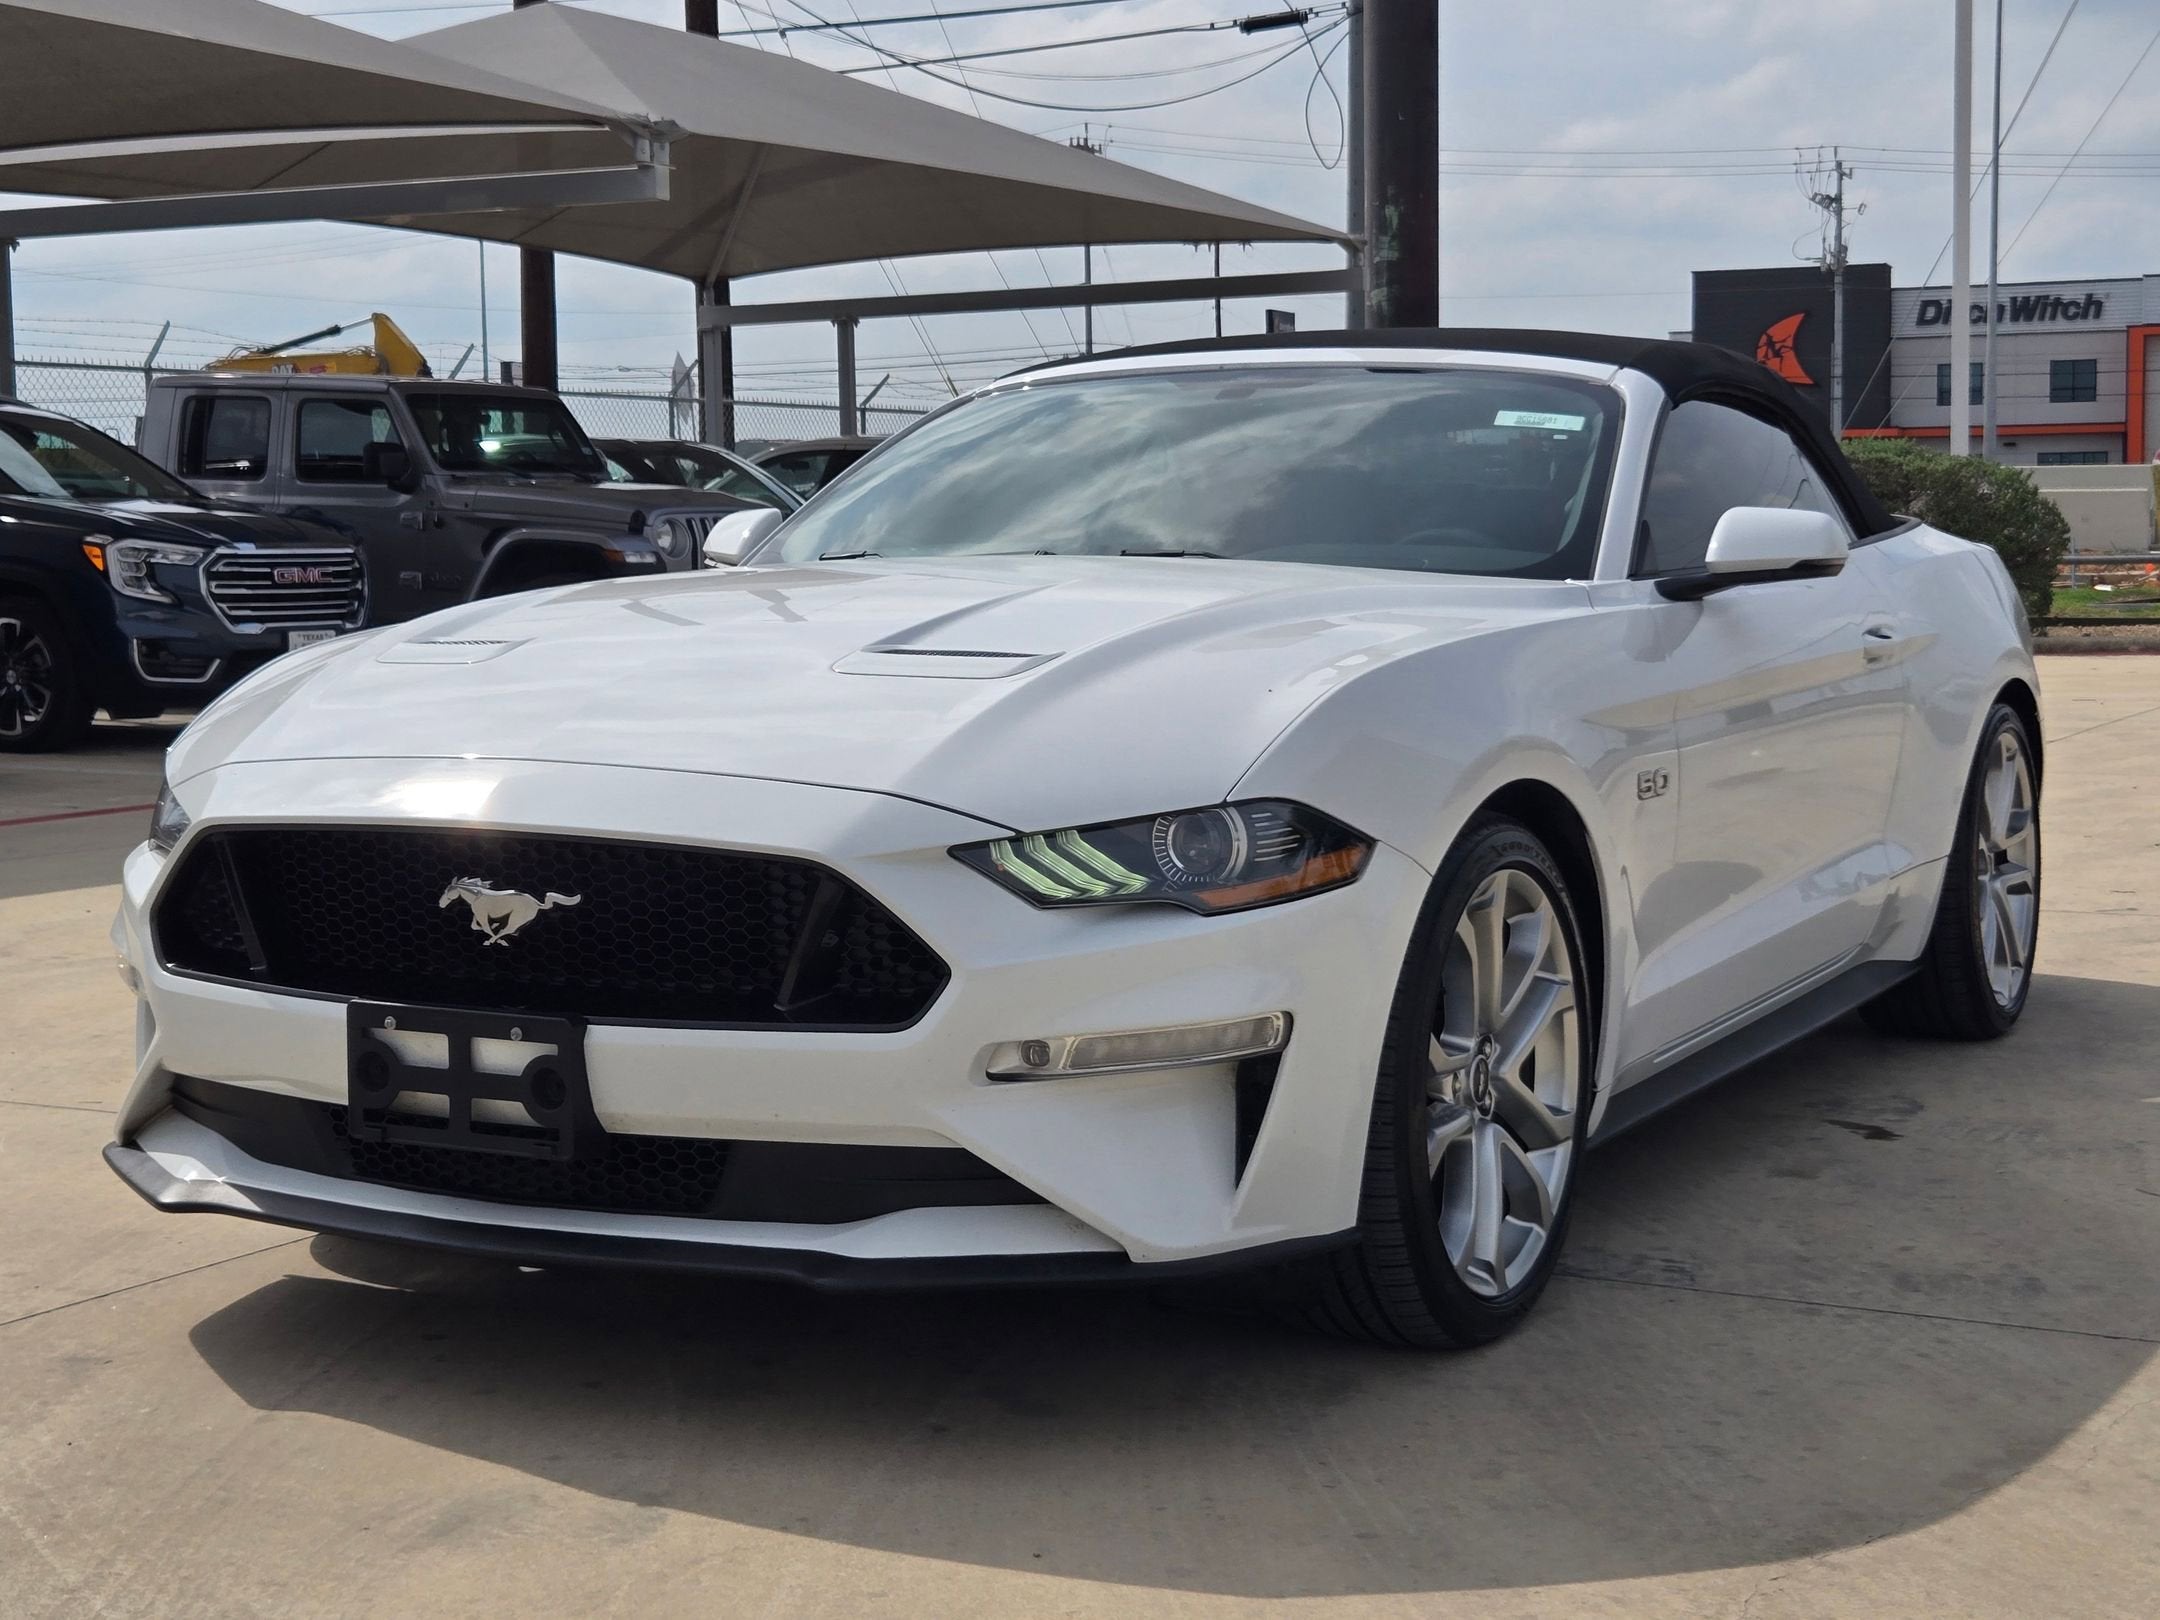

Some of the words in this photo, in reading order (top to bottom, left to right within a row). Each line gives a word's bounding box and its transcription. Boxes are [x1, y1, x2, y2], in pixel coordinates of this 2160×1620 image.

[1916, 298, 2006, 326] Dich
[2009, 293, 2104, 322] Witch
[274, 567, 333, 584] GMC
